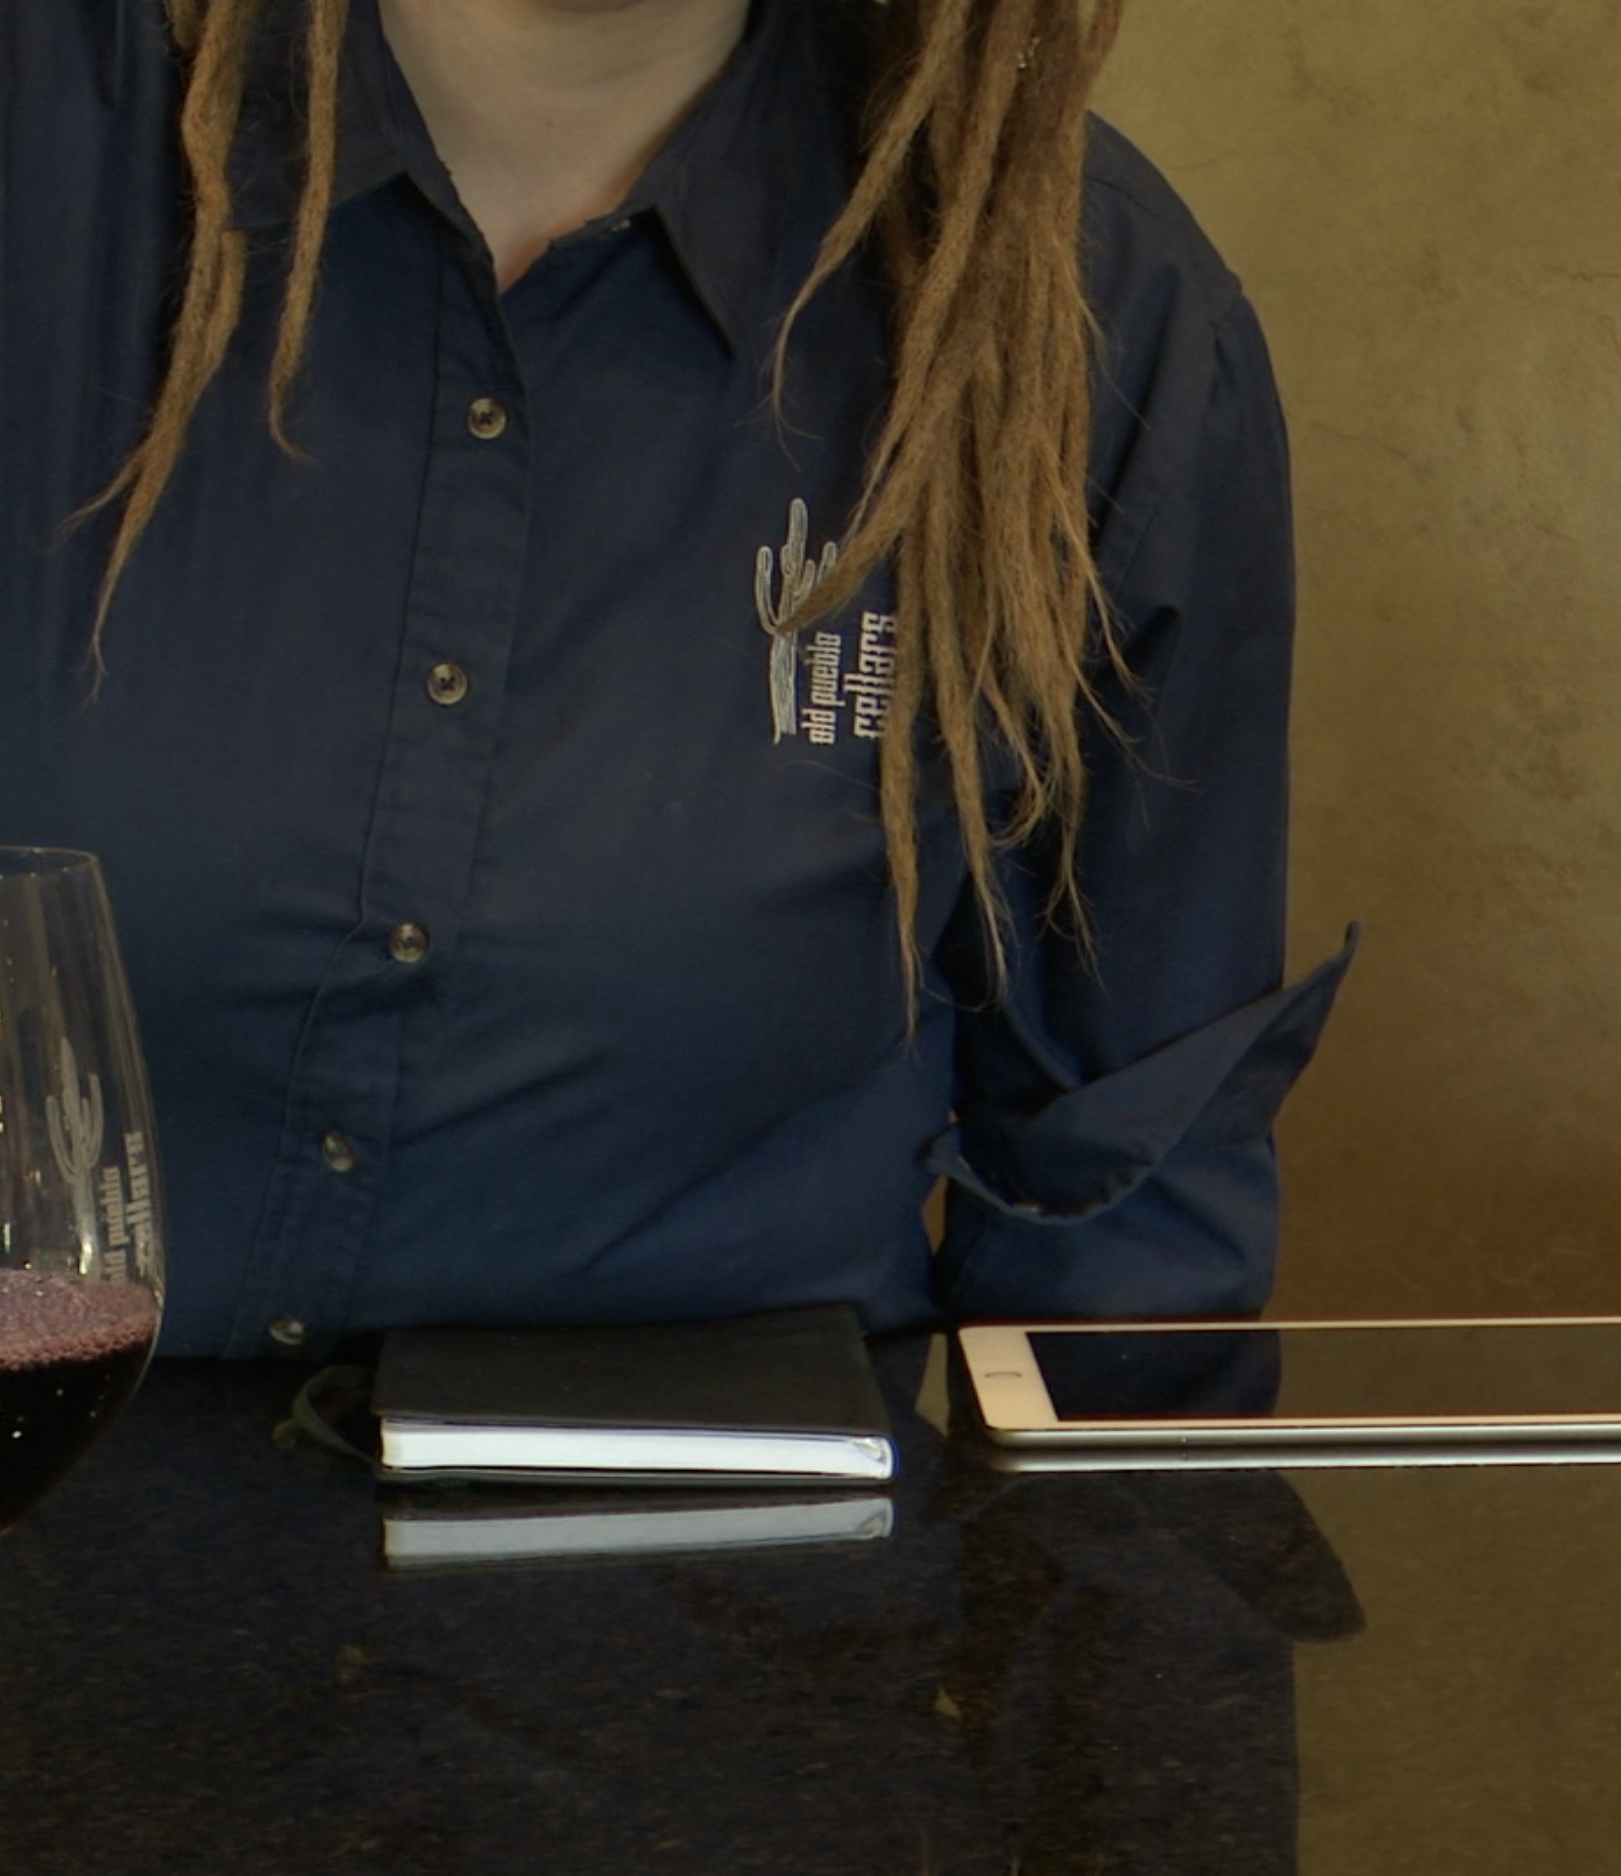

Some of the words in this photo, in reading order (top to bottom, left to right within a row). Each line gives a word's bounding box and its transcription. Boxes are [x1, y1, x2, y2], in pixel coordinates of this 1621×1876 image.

[804, 632, 846, 707] pueblo
[843, 612, 898, 739] cellars
[801, 708, 836, 744] old
